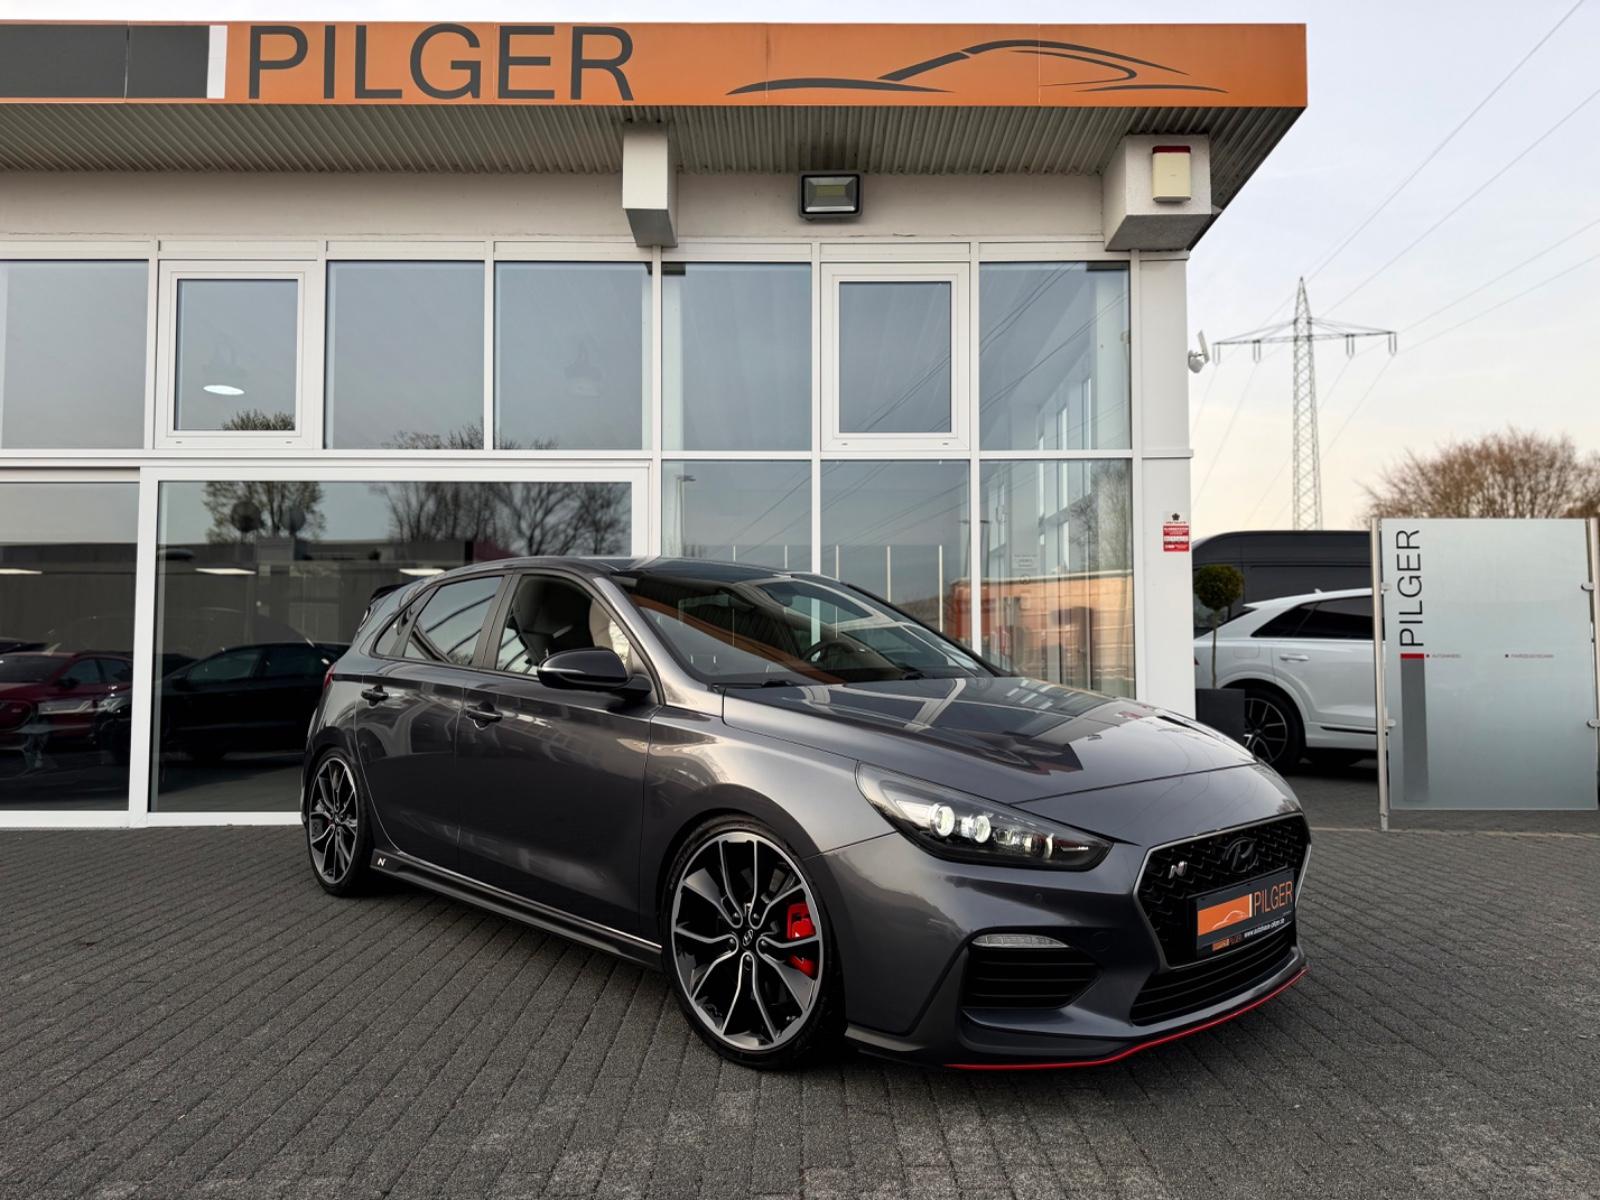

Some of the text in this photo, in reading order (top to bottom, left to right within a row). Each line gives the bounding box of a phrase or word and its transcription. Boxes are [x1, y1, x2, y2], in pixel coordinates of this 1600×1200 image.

[248, 23, 634, 101] PILGER
[1395, 530, 1424, 647] PILGER
[377, 857, 387, 867] N
[1168, 860, 1188, 880] N
[1254, 881, 1293, 917] PILGER
